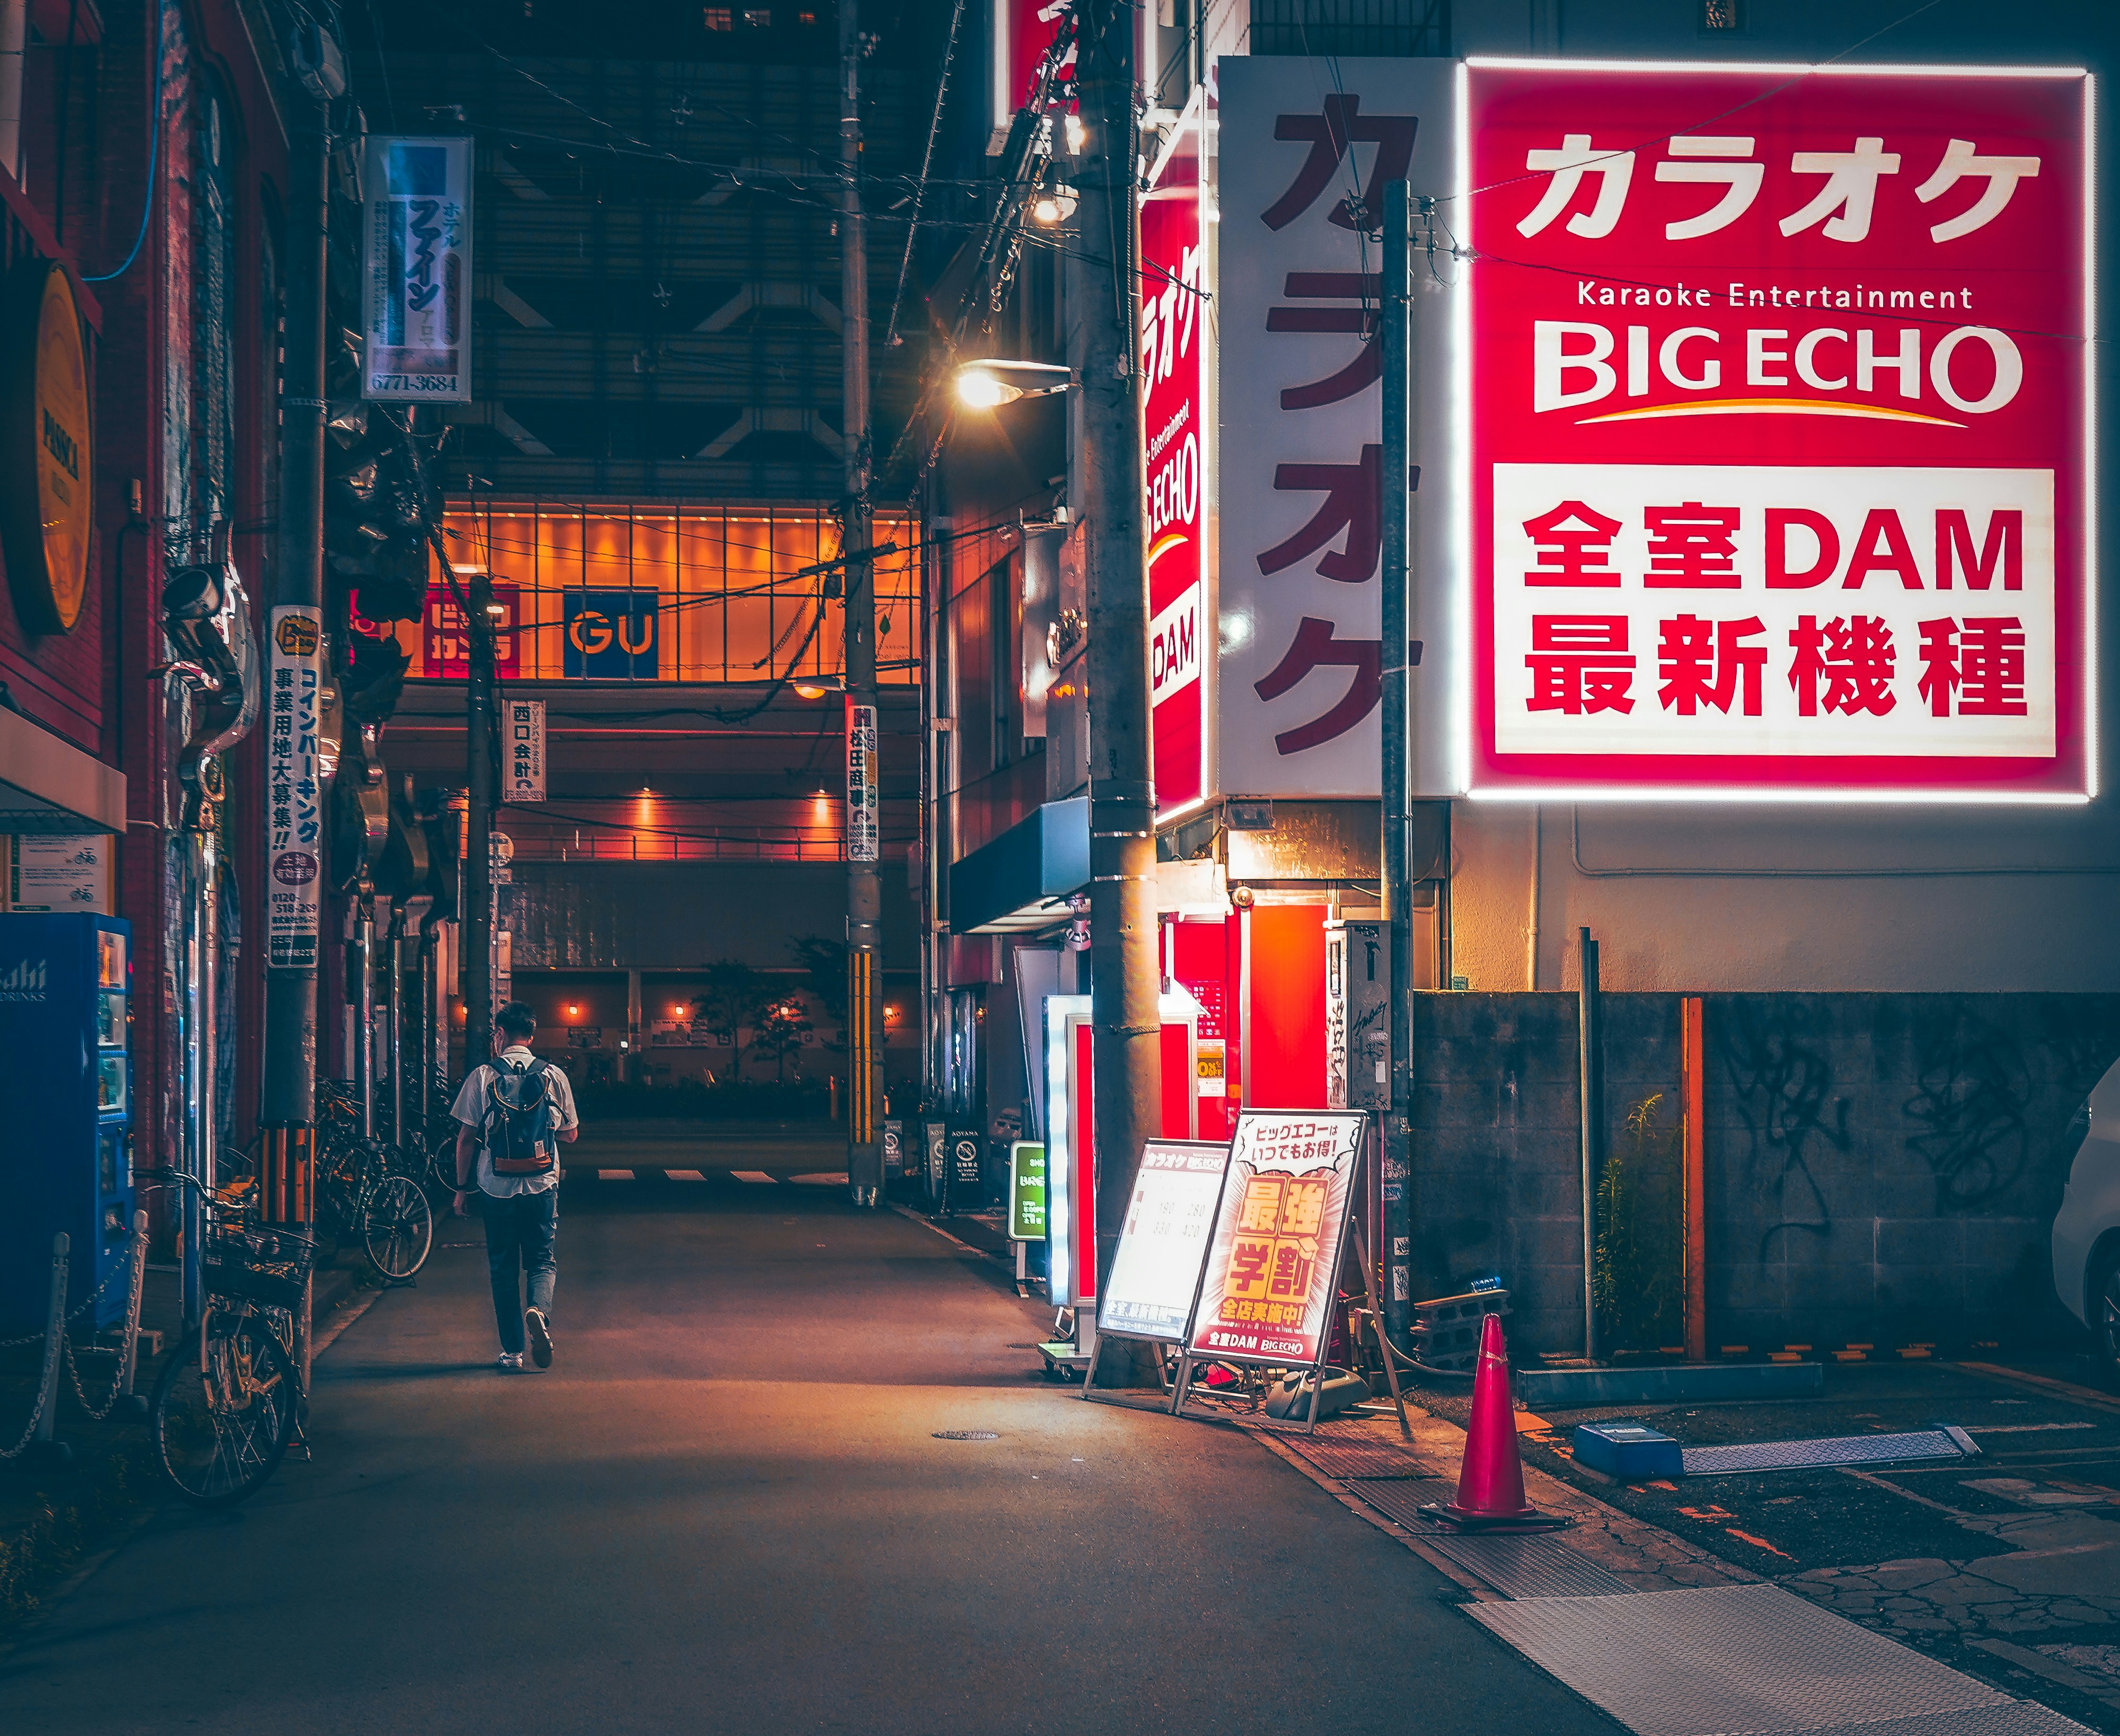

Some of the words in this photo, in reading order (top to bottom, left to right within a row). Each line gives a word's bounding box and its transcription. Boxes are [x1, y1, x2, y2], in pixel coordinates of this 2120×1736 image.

[1516, 134, 2041, 243] カラオケ
[443, 202, 462, 249] ホテル
[1578, 281, 1711, 307] Karaoke
[1728, 282, 1973, 309] Entertainment
[372, 375, 458, 392] 6771-3684
[1534, 320, 1721, 413] BIG
[1746, 325, 2024, 414] ECHO
[1254, 94, 1424, 756] カラオケ
[1522, 500, 2024, 591] 全室DAM
[569, 611, 654, 654] GU
[1153, 605, 1195, 691] DAM
[1525, 614, 2028, 717] 最新機種
[297, 669, 319, 844] コインパーキング
[1252, 1140, 1337, 1161] いつでもお得!
[1256, 1122, 1338, 1142] ビッグエコーは
[1239, 1181, 1325, 1235] 最強
[1231, 1243, 1311, 1297] 学割
[1221, 1298, 1304, 1327] 全店実施中!
[1208, 1332, 1258, 1350] 全室DAM
